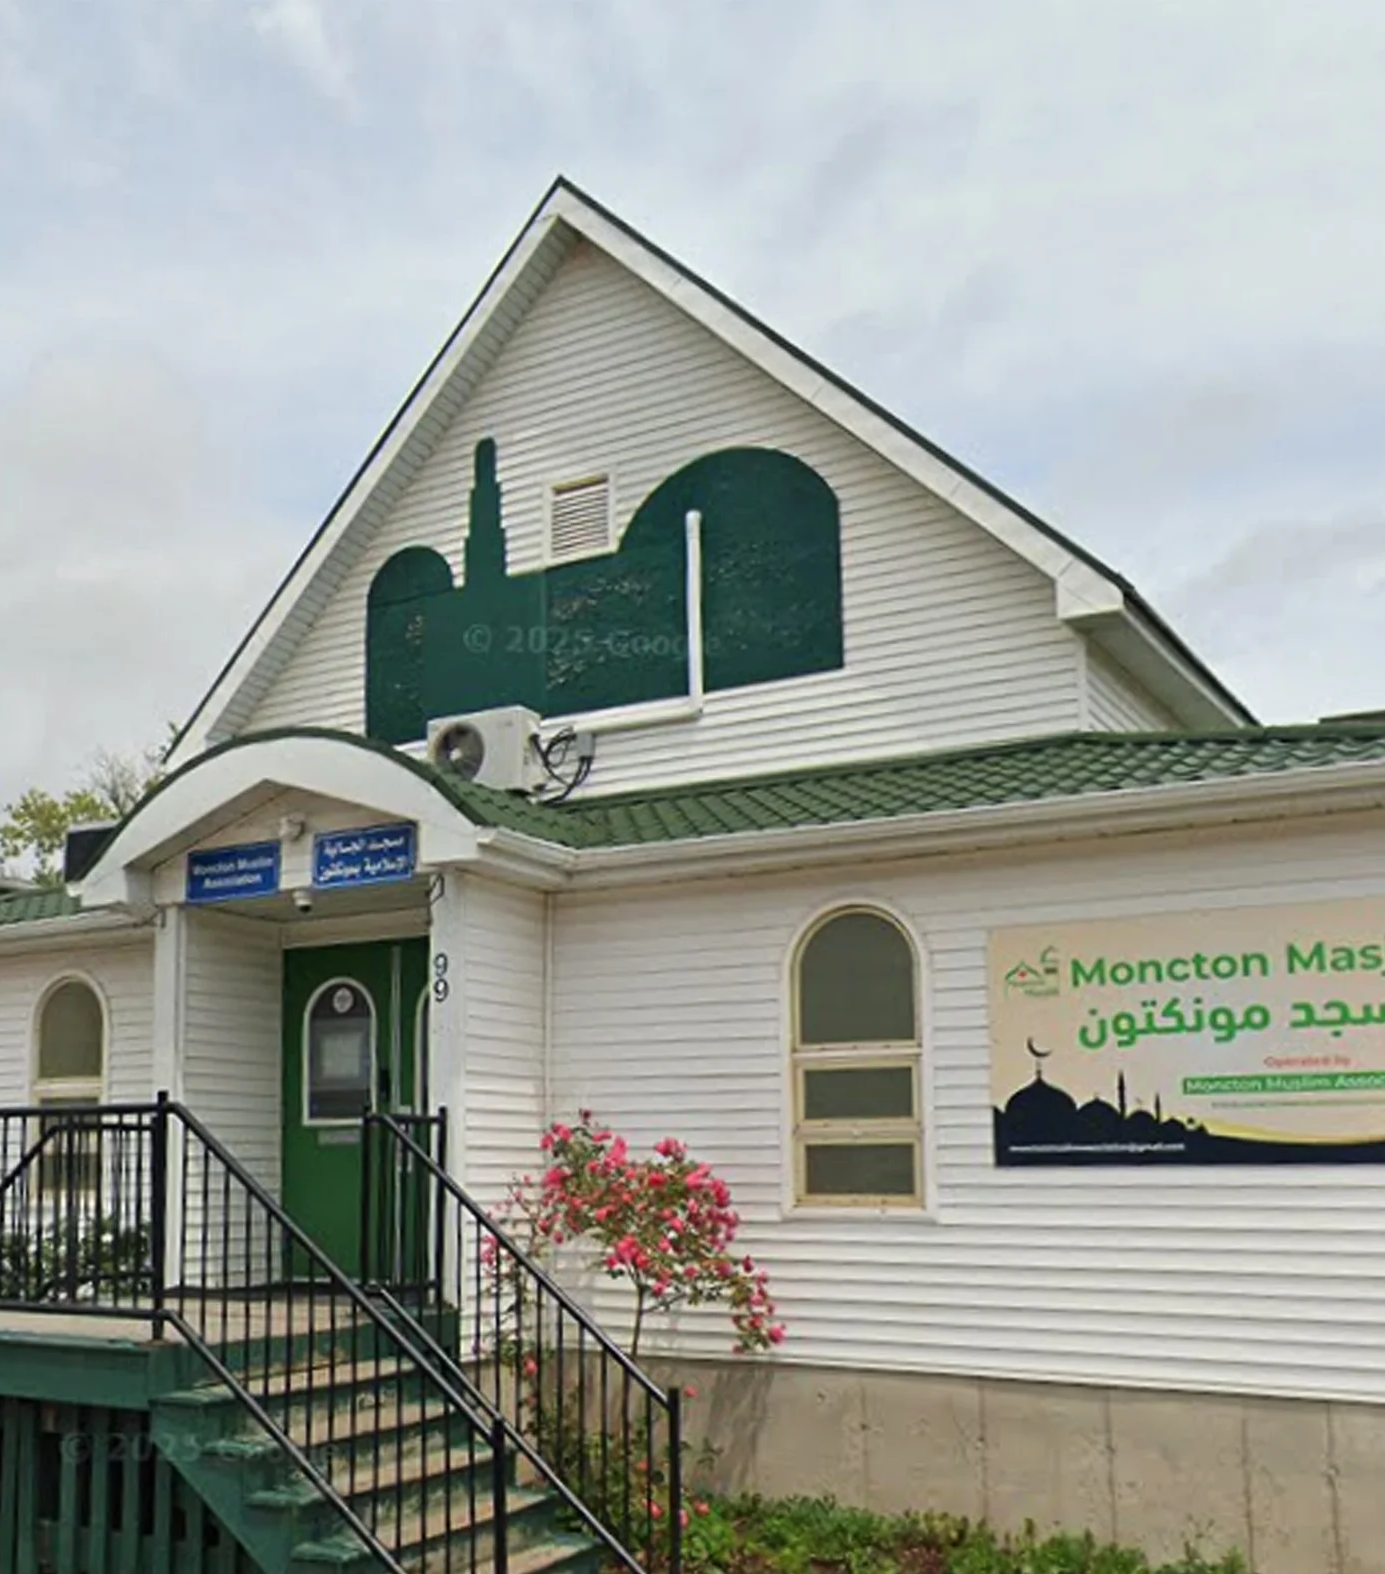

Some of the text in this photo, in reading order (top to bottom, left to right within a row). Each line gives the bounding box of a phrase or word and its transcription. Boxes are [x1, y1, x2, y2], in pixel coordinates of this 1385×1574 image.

[1071, 953, 1270, 987] Moncton
[1079, 997, 1271, 1049] مونكتون
[1265, 1056, 1351, 1069] Operated by
[1186, 1078, 1262, 1092] Moncton
[1267, 1076, 1332, 1091] Muslim
